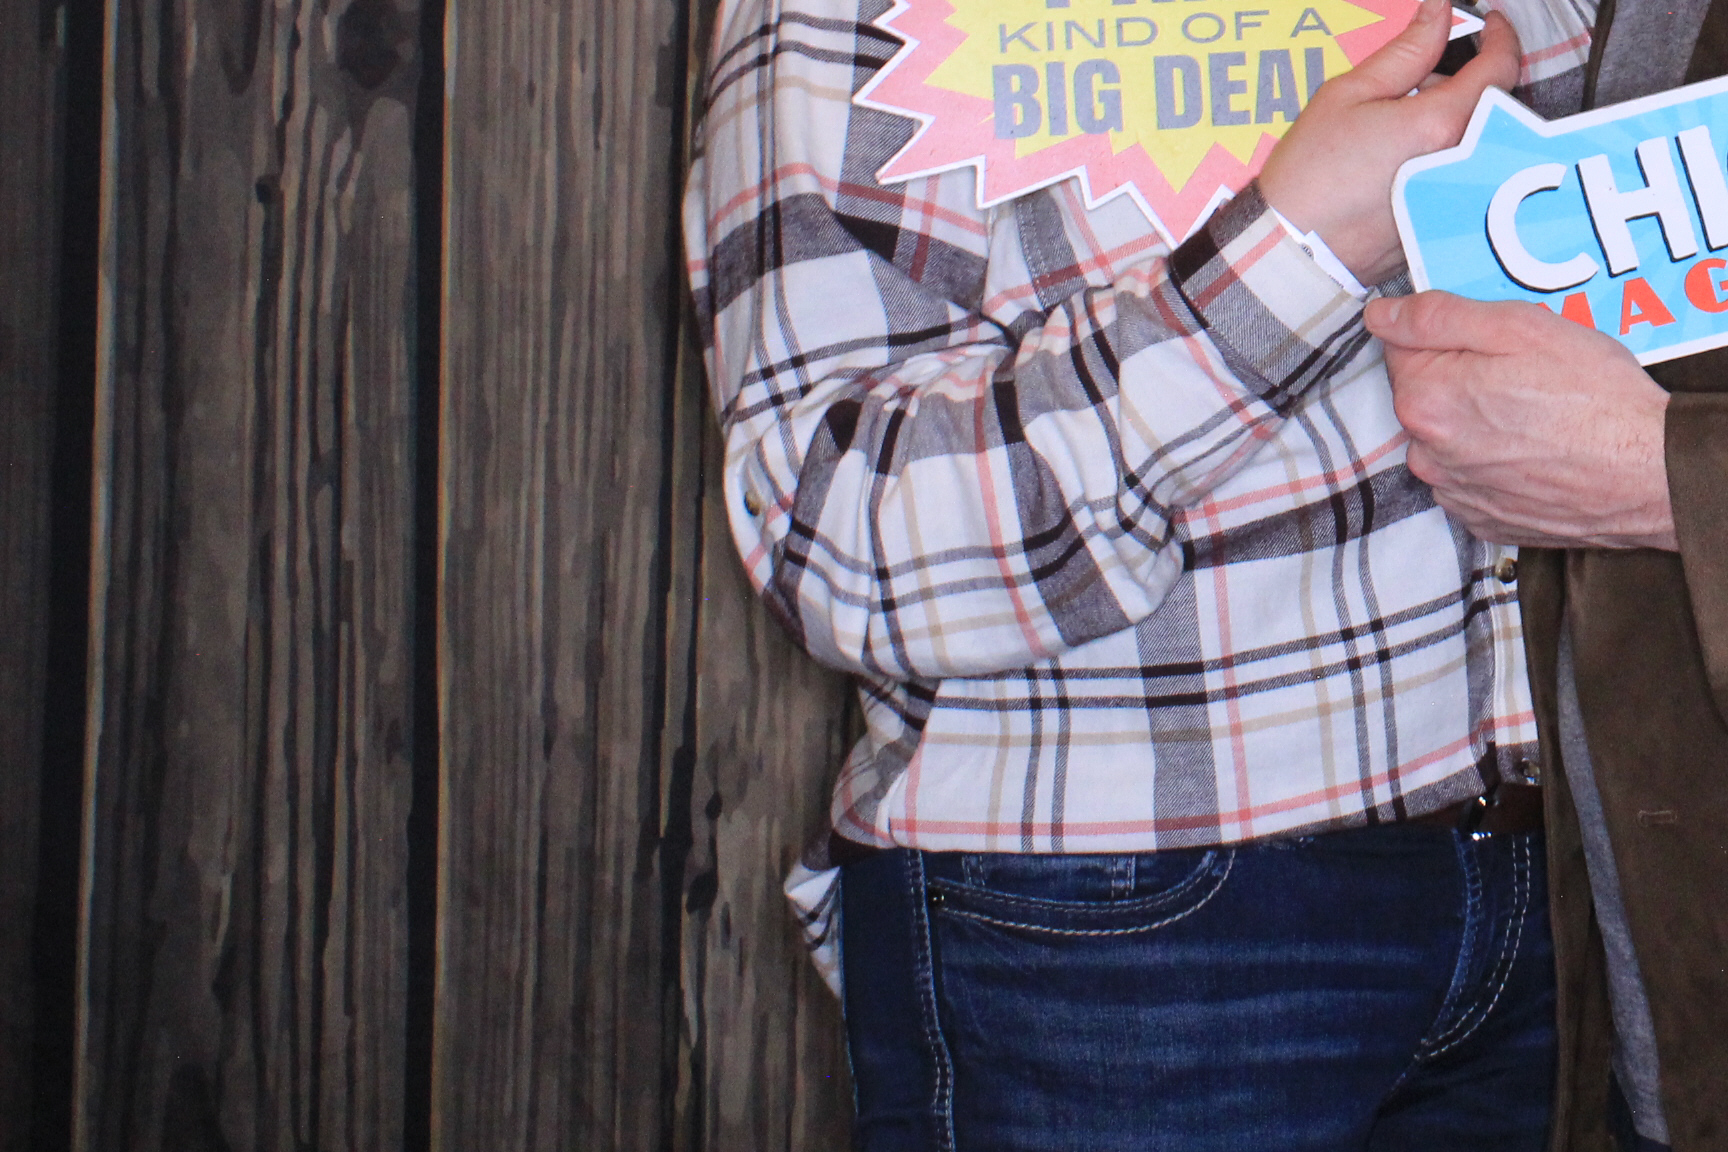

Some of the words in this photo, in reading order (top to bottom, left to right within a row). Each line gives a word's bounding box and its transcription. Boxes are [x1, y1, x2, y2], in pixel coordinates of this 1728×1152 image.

[998, 14, 1159, 54] KIND
[1181, 9, 1269, 44] OF
[1289, 6, 1333, 39] A
[991, 58, 1122, 140] BIG
